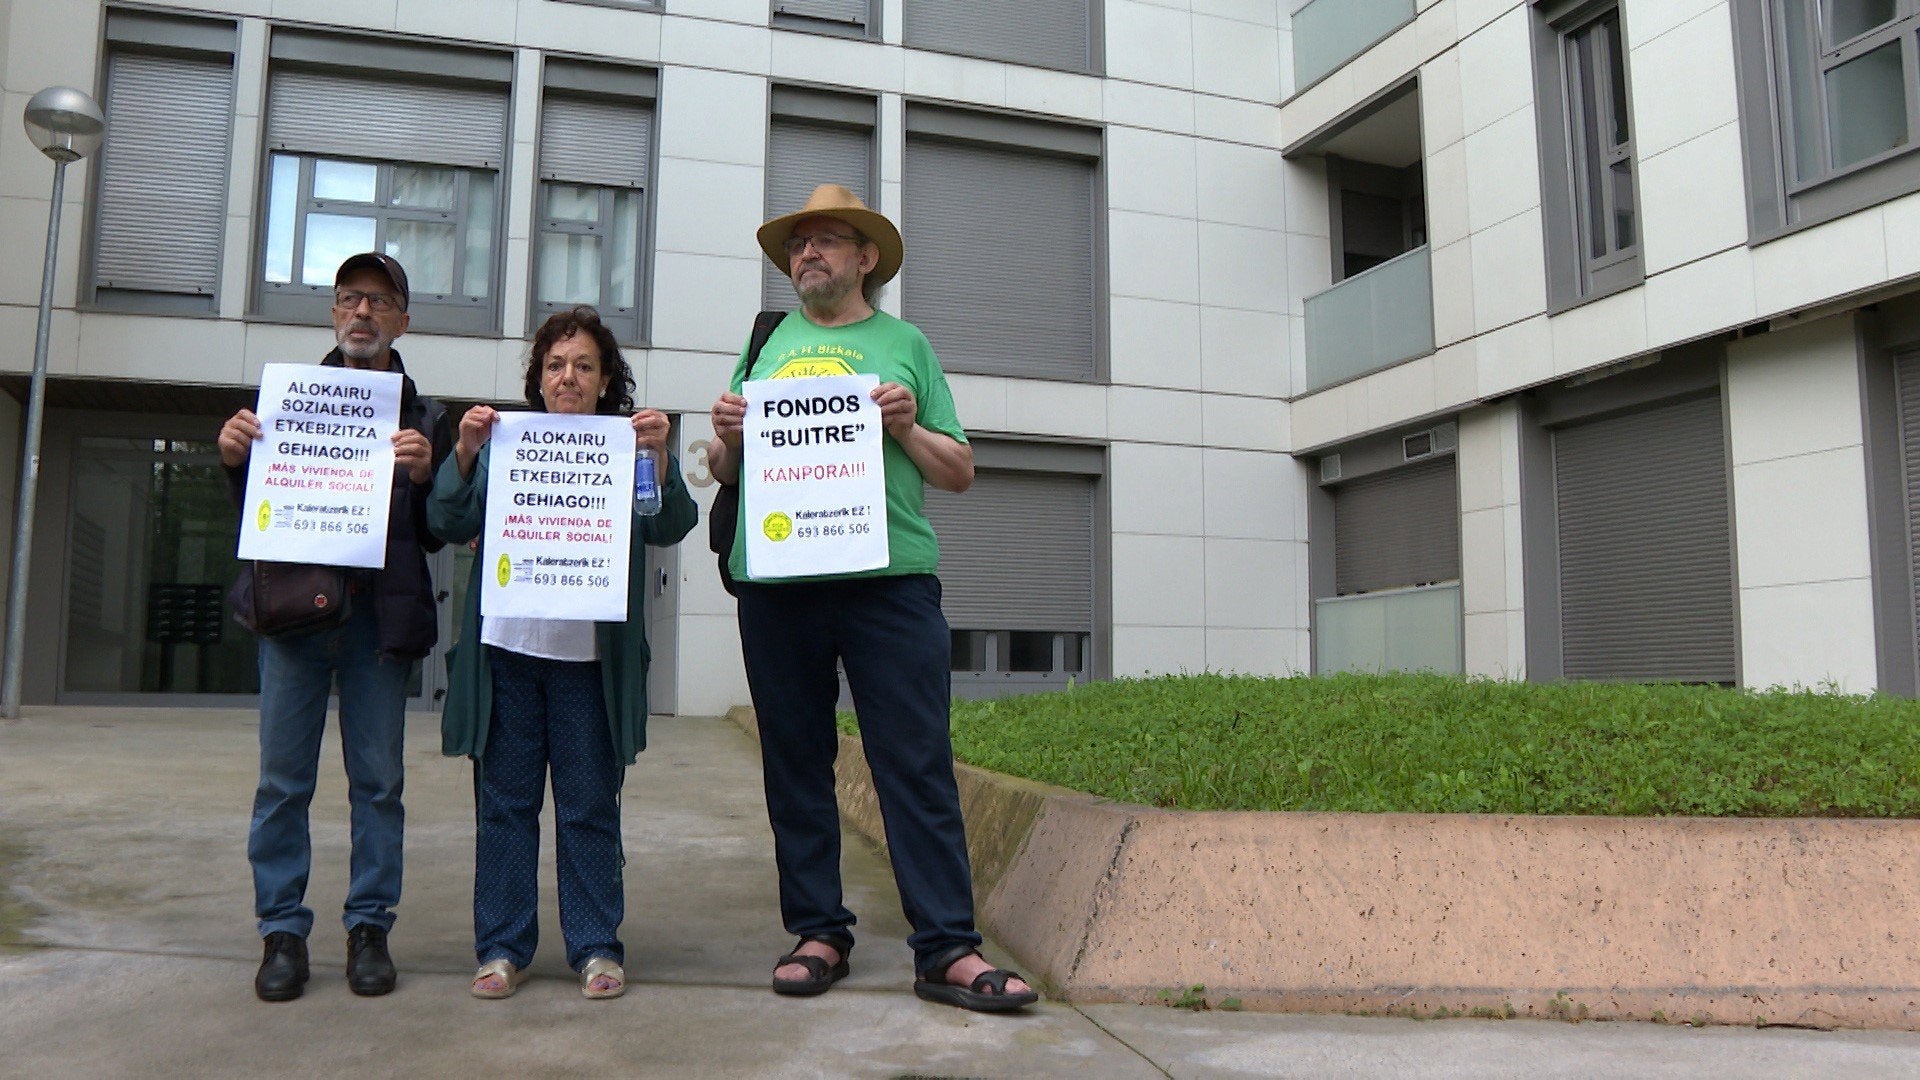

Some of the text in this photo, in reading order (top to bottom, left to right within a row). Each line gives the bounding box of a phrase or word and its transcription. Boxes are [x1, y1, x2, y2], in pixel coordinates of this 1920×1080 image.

[287, 381, 372, 400] ALOKAIRU
[281, 399, 375, 418] SOZIALEKO
[763, 395, 860, 418] FONDOS
[275, 419, 377, 439] ETXEBIZITZA
[521, 431, 605, 446] ALOKAIRU
[278, 442, 369, 461] GEHIAGO!!!
[515, 449, 610, 465] SOZIALEKO
[268, 462, 374, 478] ¡MÁS VIVIENDA DE
[687, 439, 715, 488] 3
[509, 469, 613, 486] ETXEBIZITZA
[763, 462, 866, 483] KANPORA!!!
[264, 477, 374, 492] ALQUILER SOCIAL!
[513, 493, 606, 510] GEHIAGO!!!
[351, 505, 365, 516] EZ
[851, 505, 865, 516] EZ
[293, 519, 369, 534] 693 866 506
[504, 514, 612, 528] ¡MÁS VIVIENDA DE
[502, 529, 613, 543] ALQUILER SOCIAL!
[797, 526, 819, 538] 693
[822, 525, 845, 536] 866
[848, 523, 870, 535] 506
[591, 557, 605, 568] EZ
[534, 573, 610, 587] 693 866 506
